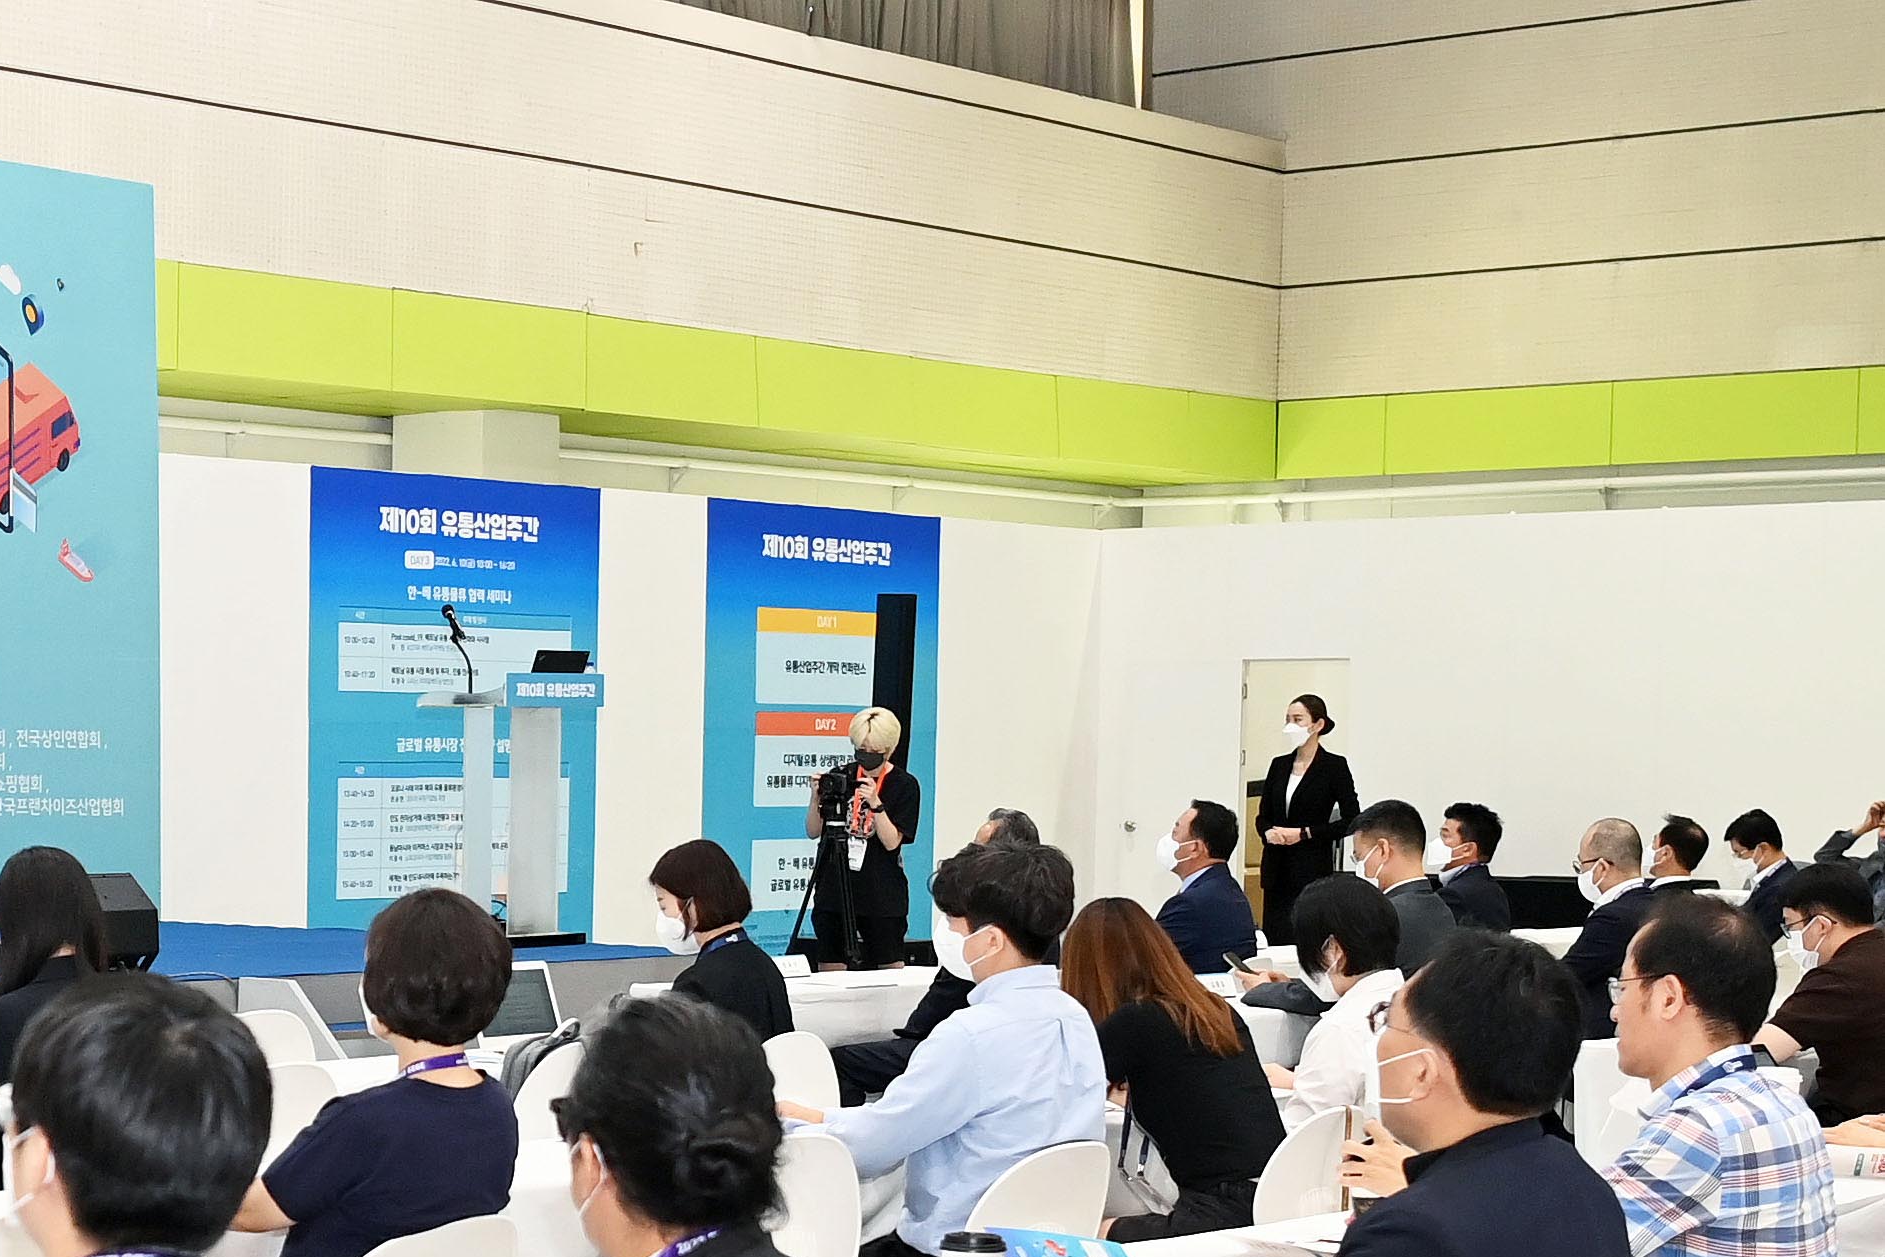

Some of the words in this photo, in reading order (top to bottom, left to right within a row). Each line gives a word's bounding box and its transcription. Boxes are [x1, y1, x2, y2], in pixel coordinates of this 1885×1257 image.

[379, 506, 437, 535] 제10회
[441, 510, 541, 543] 유통산업주간
[762, 533, 809, 560] 제10회
[811, 537, 892, 567] 유통산업주간
[516, 682, 544, 697] 제10회
[546, 683, 595, 697] 유통산업주간
